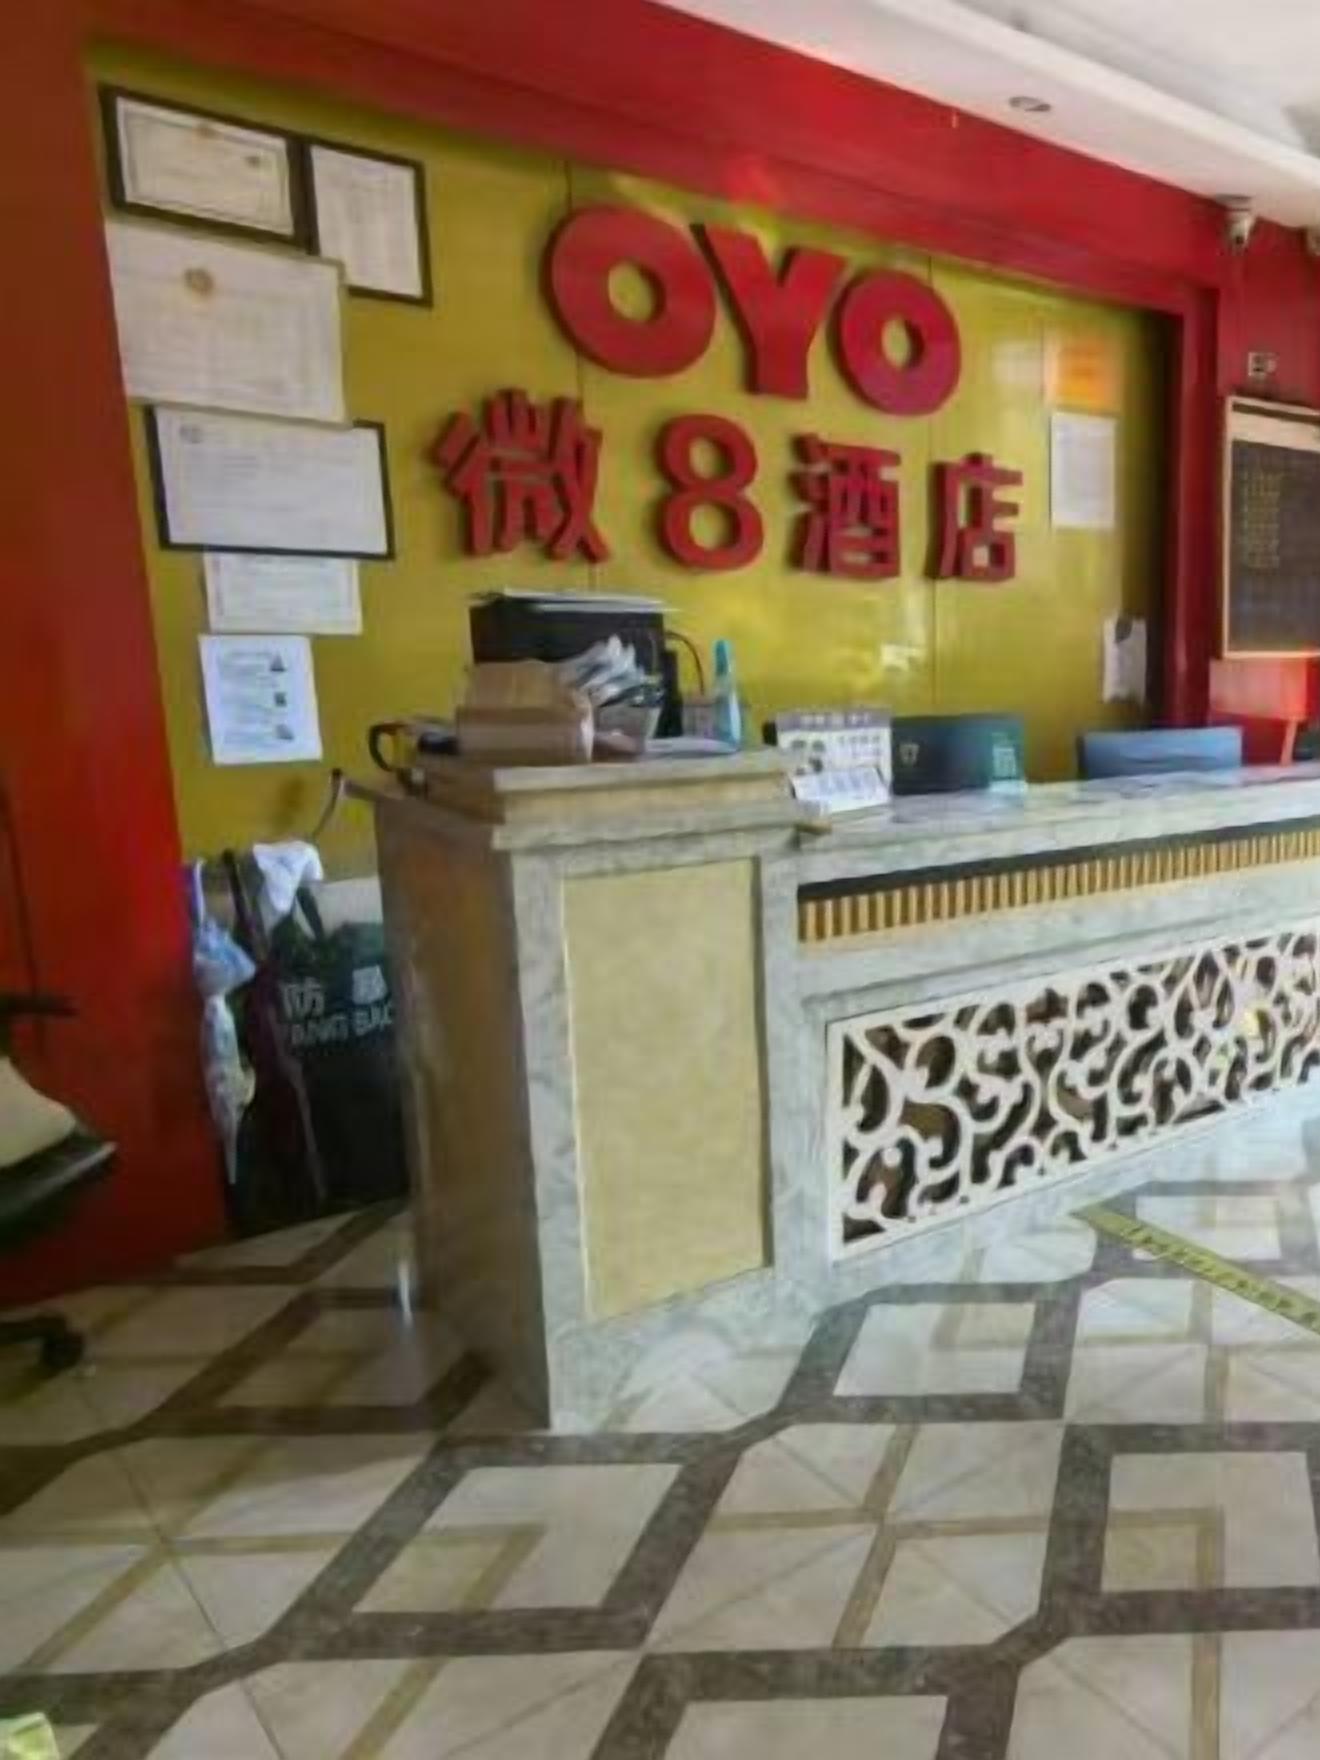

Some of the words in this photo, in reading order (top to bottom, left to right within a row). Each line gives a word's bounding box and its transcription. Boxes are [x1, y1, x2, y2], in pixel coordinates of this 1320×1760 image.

[541, 203, 961, 417] OYO
[431, 389, 1023, 583] 微8酒店
